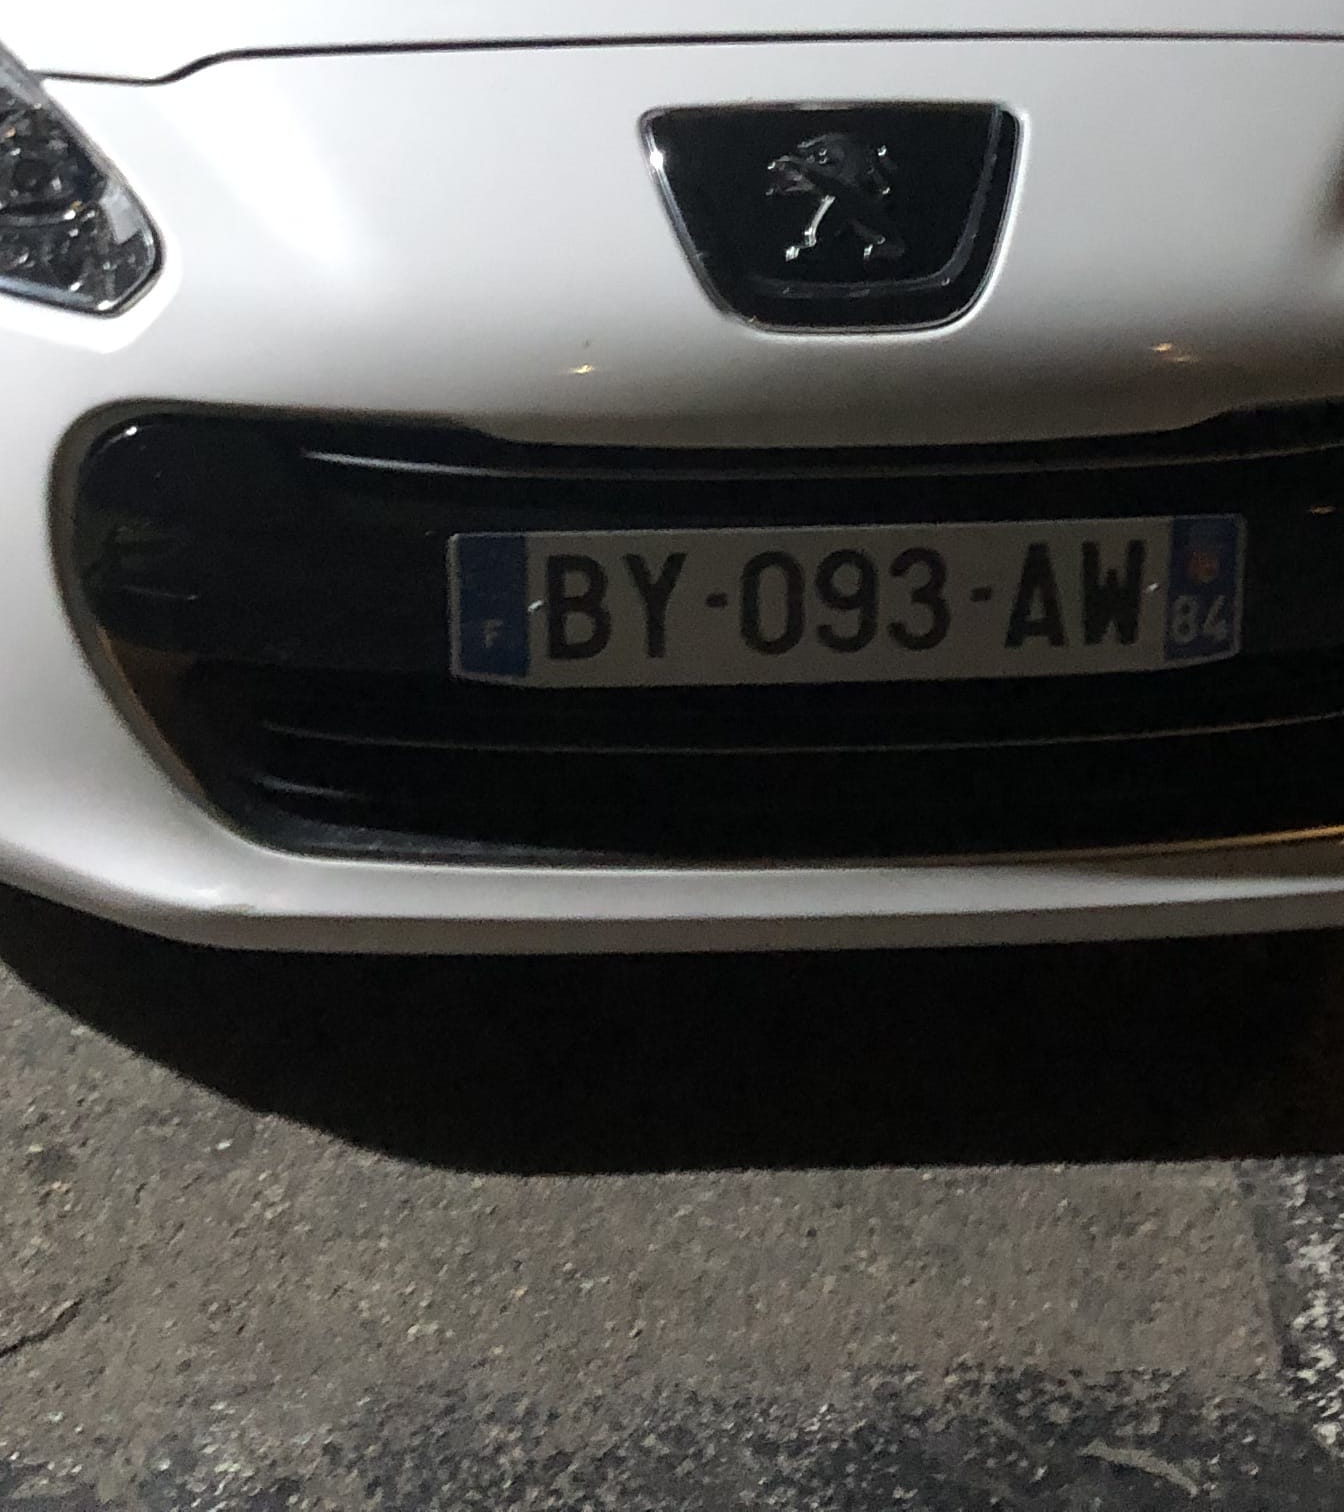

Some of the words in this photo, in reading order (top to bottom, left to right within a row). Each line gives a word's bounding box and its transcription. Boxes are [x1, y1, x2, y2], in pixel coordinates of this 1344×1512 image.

[545, 540, 1146, 661] BY-093-AW
[1168, 593, 1230, 645] 84
[480, 619, 500, 649] F
